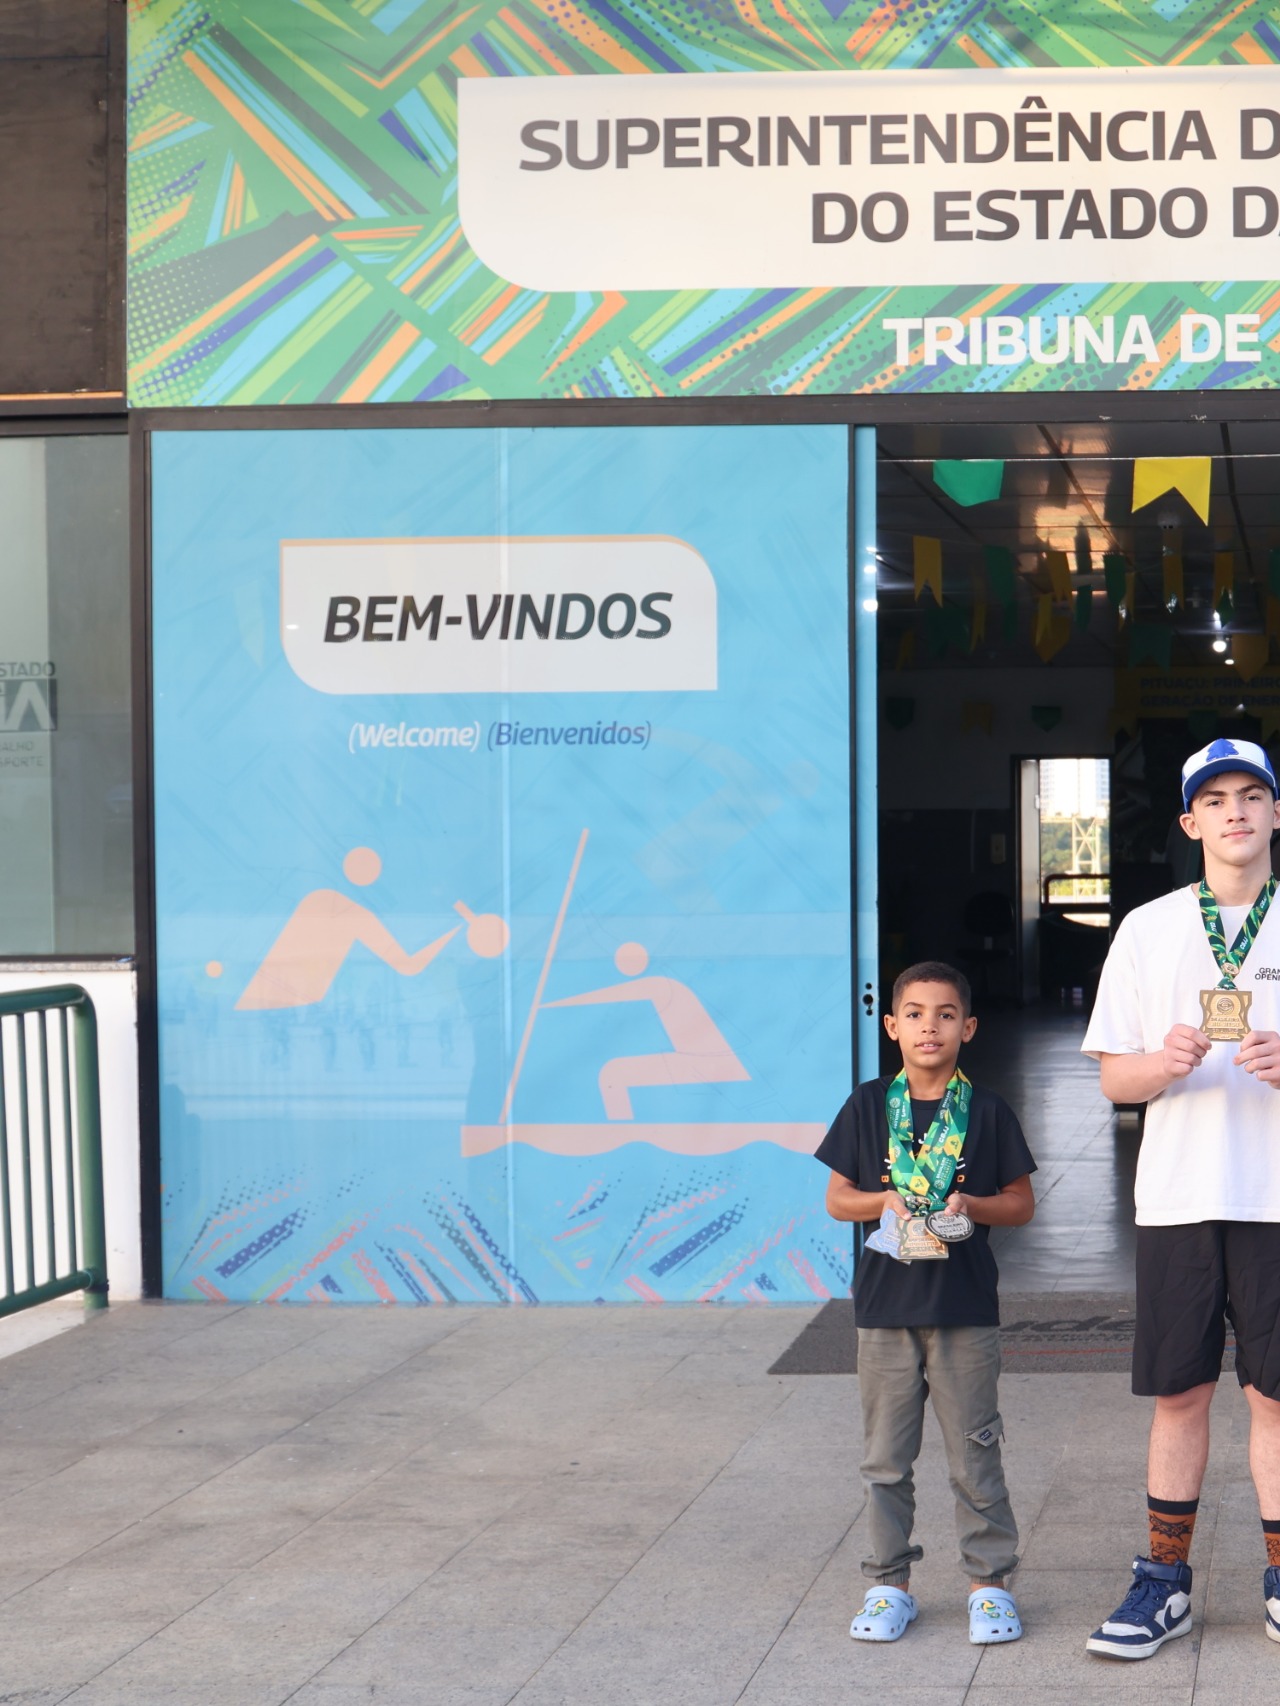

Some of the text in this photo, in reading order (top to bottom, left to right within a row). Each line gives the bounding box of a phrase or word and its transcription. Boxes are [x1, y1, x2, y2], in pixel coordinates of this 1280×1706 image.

[518, 95, 1217, 171] SUPERINTENDÊNCIA
[811, 191, 910, 244] DO
[933, 187, 1208, 241] ESTADO
[882, 314, 1161, 367] TRIBUNA
[1179, 313, 1262, 363] DE
[323, 591, 674, 643] BEM-VINDOS
[348, 720, 652, 753] (Welcome) (Bienvenidos)
